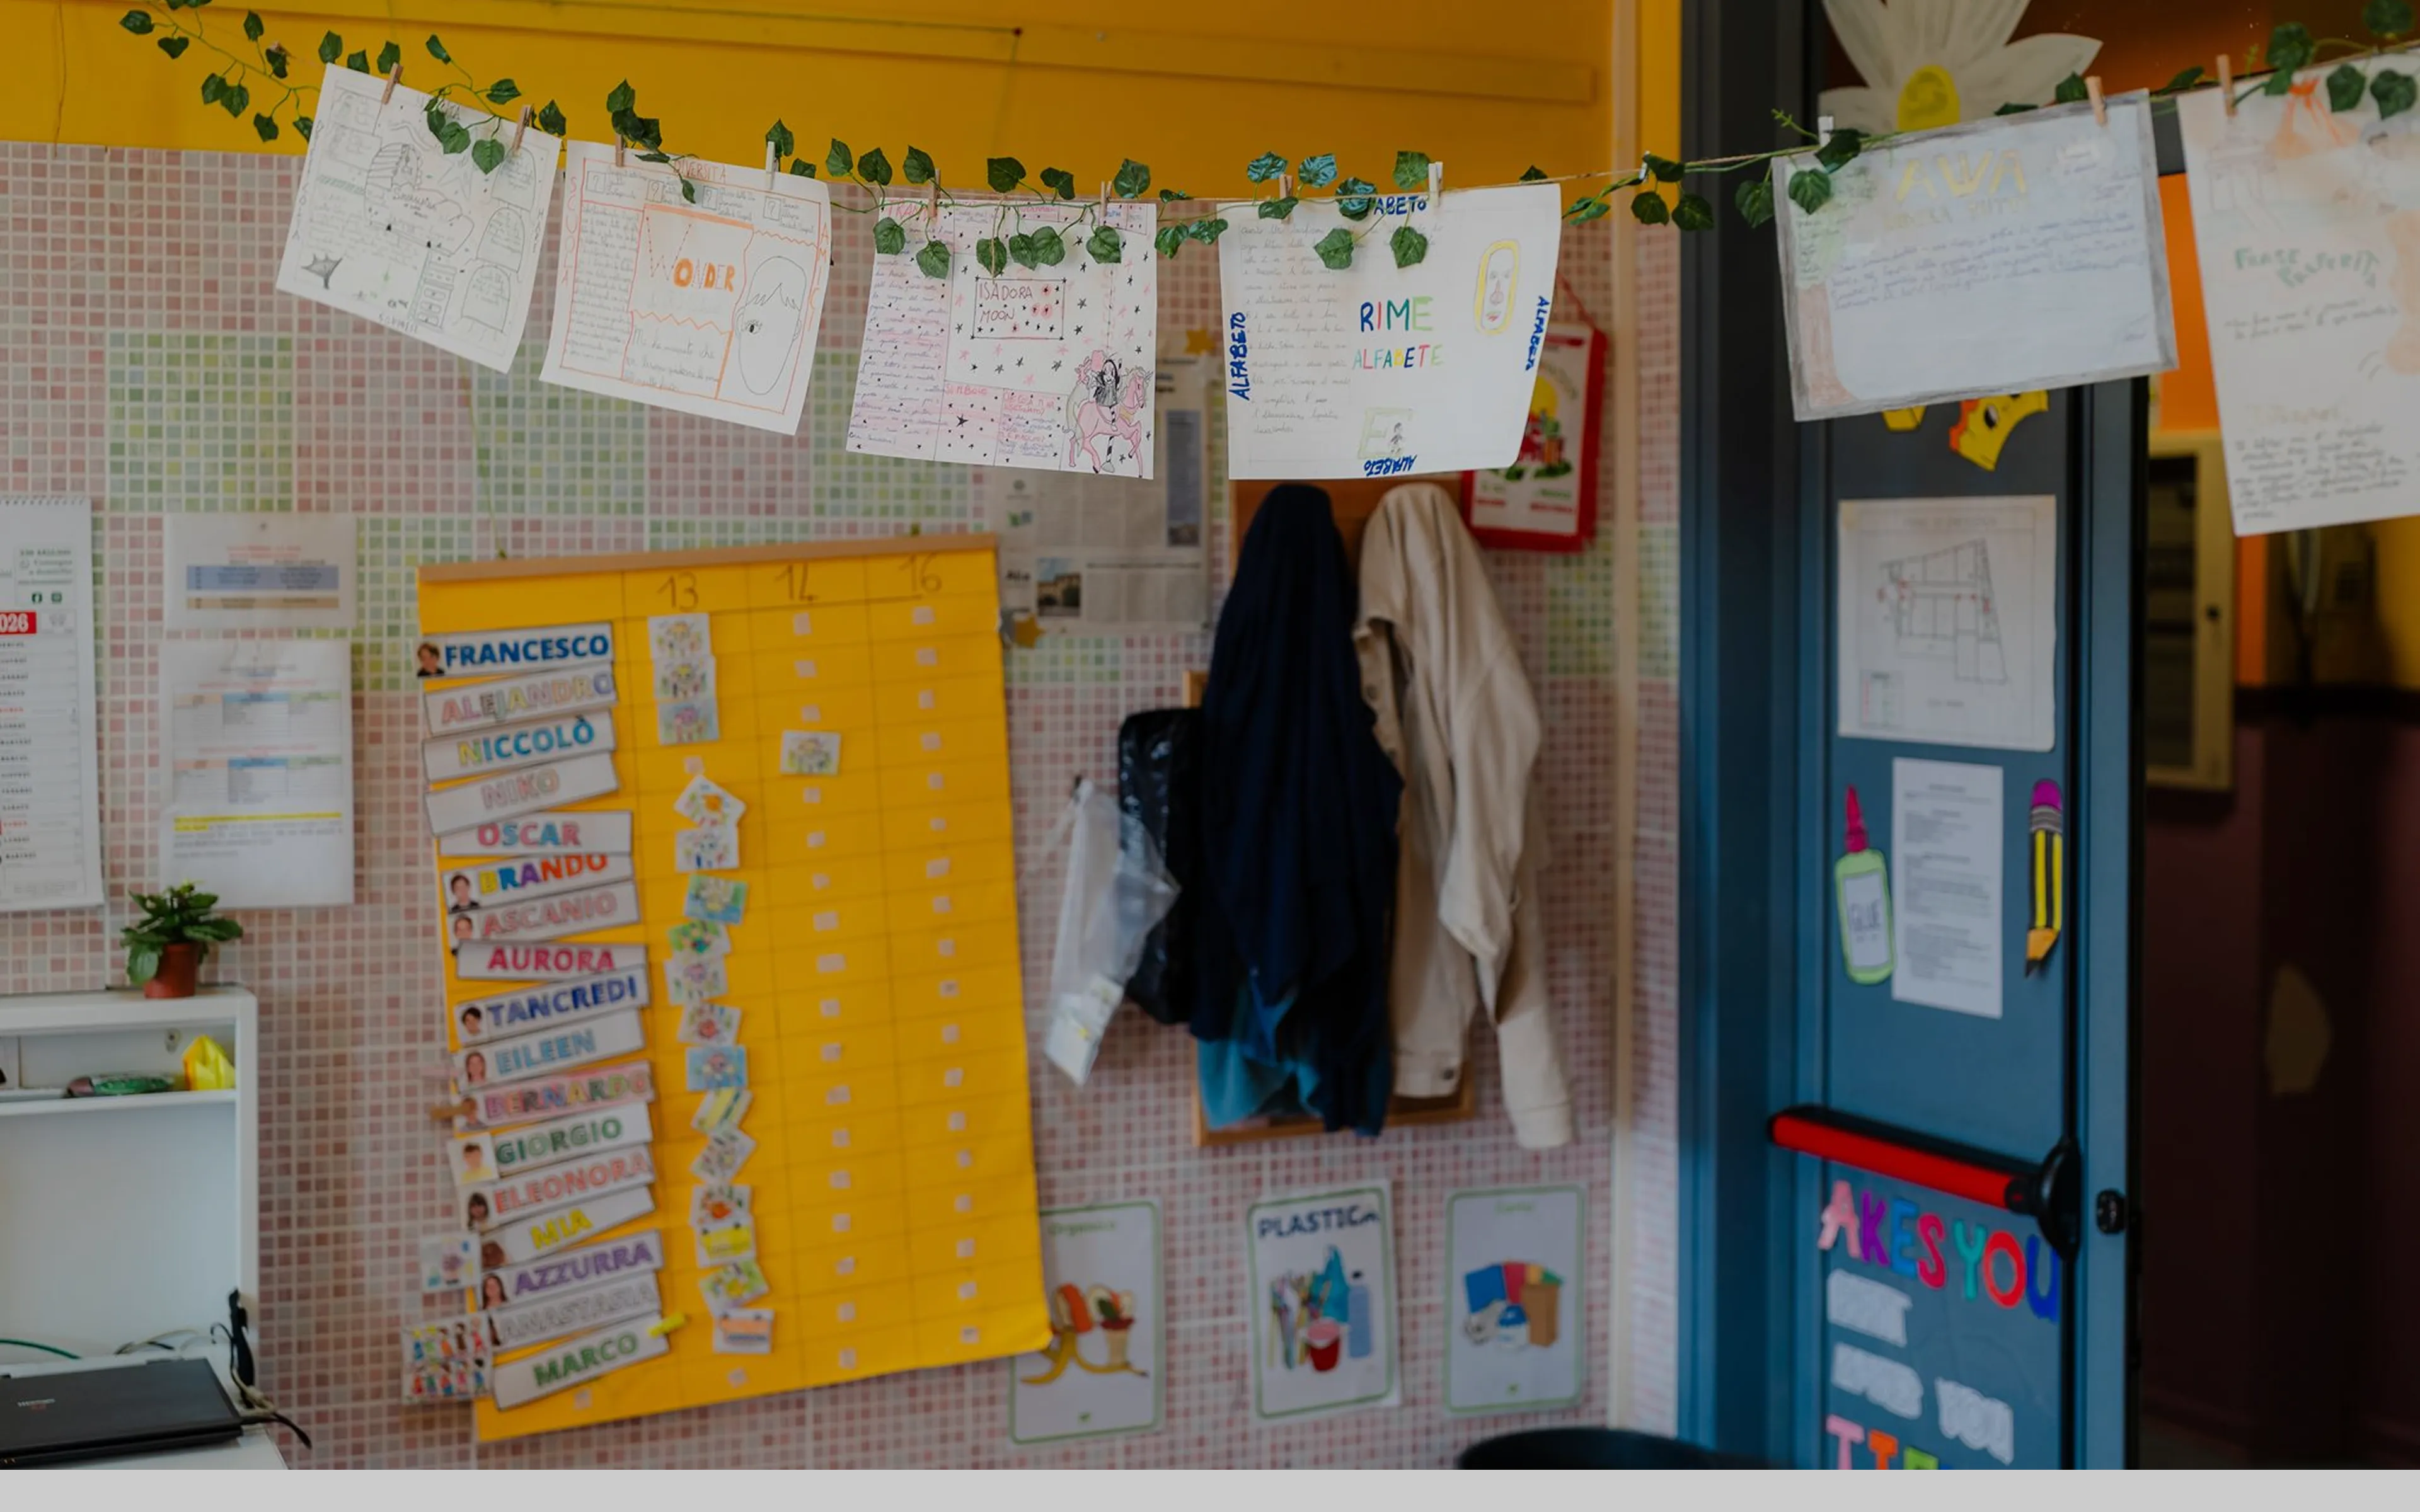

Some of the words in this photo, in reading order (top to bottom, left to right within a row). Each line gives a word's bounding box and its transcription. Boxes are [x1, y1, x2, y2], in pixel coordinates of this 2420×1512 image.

[645, 216, 735, 292] WONDER
[979, 282, 1033, 301] ISADORA
[980, 309, 1015, 323] MOON
[1360, 295, 1434, 333] RIME
[1228, 312, 1251, 401] ALFABETO
[1352, 344, 1444, 370] ALFABETE
[1364, 455, 1418, 477] ALFABETO
[657, 570, 699, 612] 13
[899, 552, 943, 593] 16
[444, 634, 609, 668] FRANCESCO
[442, 673, 613, 723] ALEJANDRO
[457, 713, 595, 767] NICCOLÒ
[480, 769, 560, 809] NIKO
[477, 822, 581, 847] OSCAR
[478, 853, 608, 895] BRANDO
[483, 890, 618, 937] ASCANIO
[486, 947, 616, 973] AURORA
[486, 974, 637, 1027] TANCREDI
[495, 1028, 597, 1075] EILEEN
[485, 1073, 650, 1120] BERNARDO
[496, 1116, 623, 1164] GIORGIO
[493, 1152, 649, 1214] ELEONORA
[531, 1208, 593, 1250] MIA
[515, 1240, 653, 1297] AZZURRA
[1952, 1217, 2060, 1321] YOU
[533, 1332, 638, 1387] MARCO
